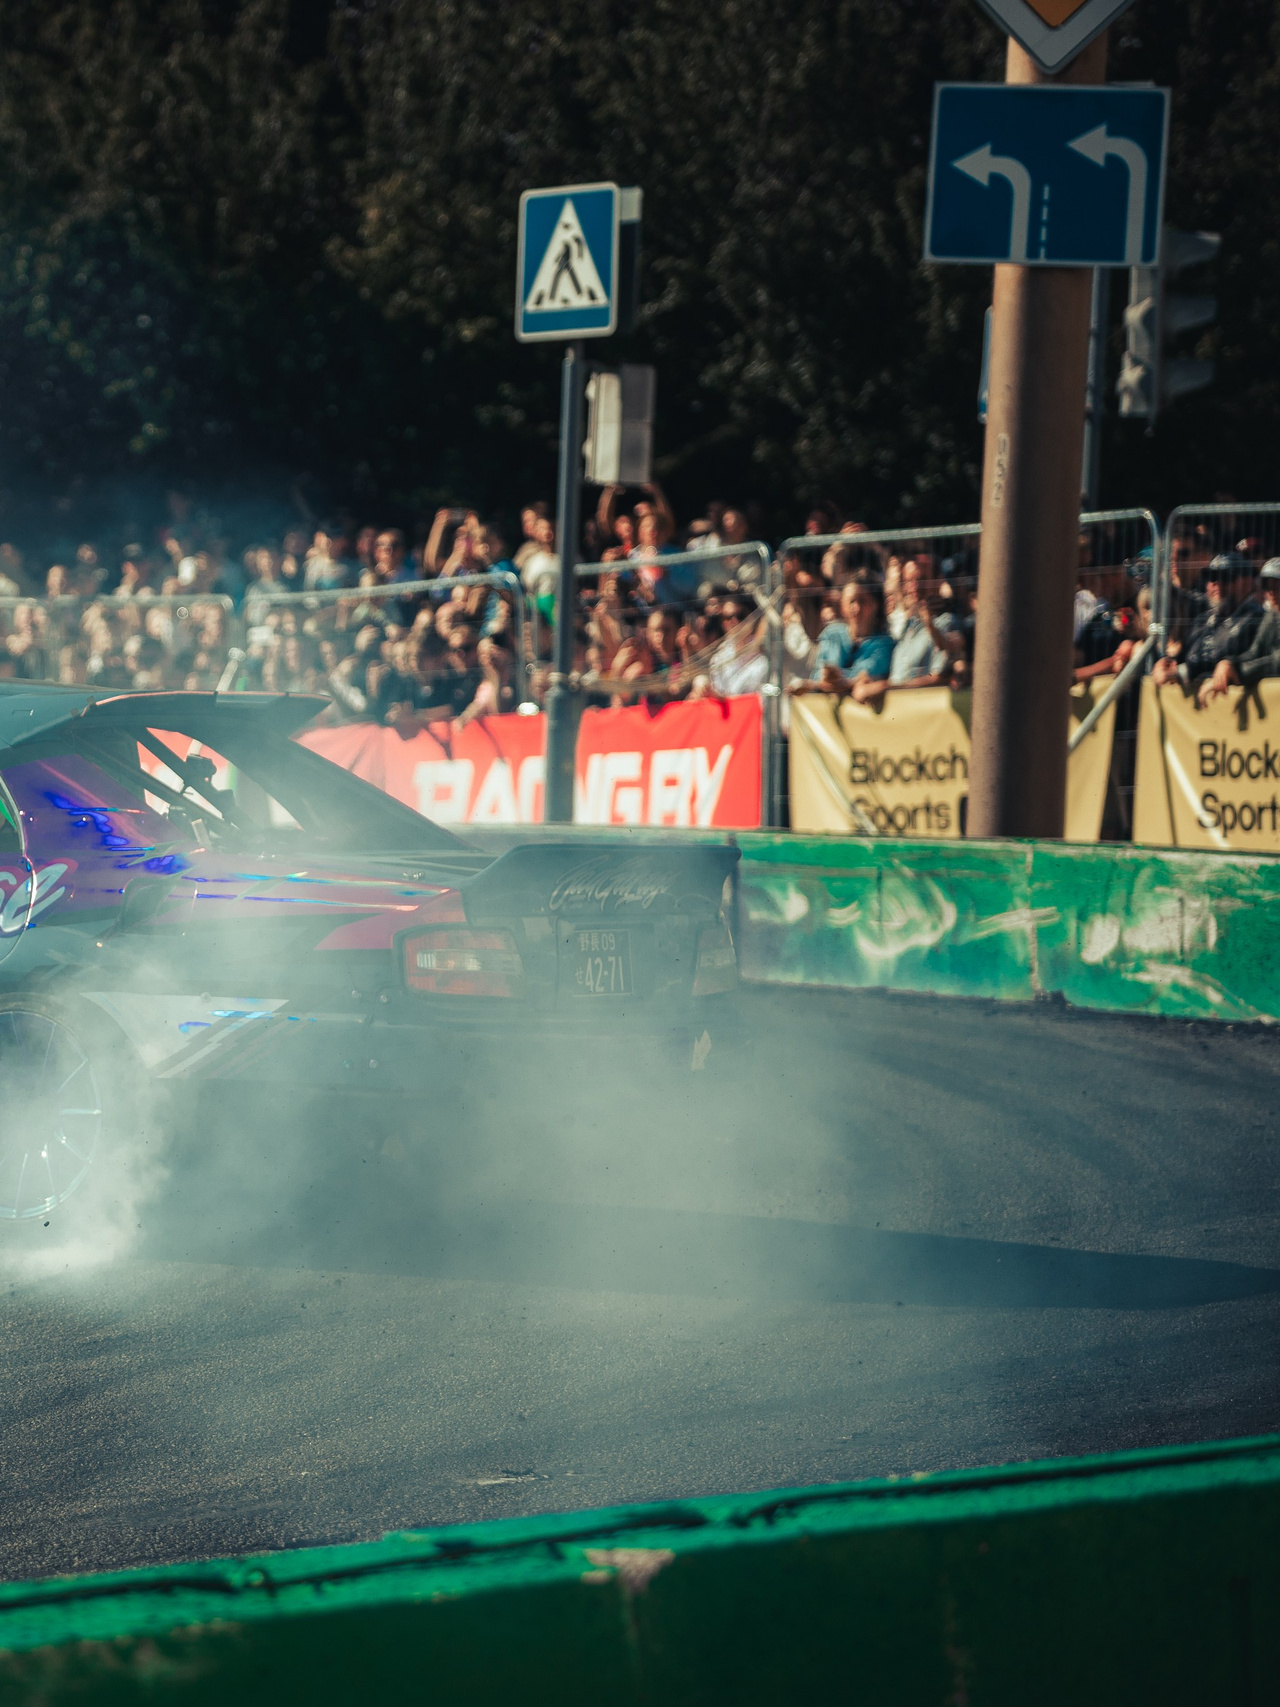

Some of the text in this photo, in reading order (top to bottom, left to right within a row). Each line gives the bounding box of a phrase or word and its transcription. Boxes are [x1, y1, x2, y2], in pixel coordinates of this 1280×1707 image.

[850, 744, 968, 783] Blockch
[1199, 739, 1280, 779] Block
[1198, 791, 1280, 838] Sport
